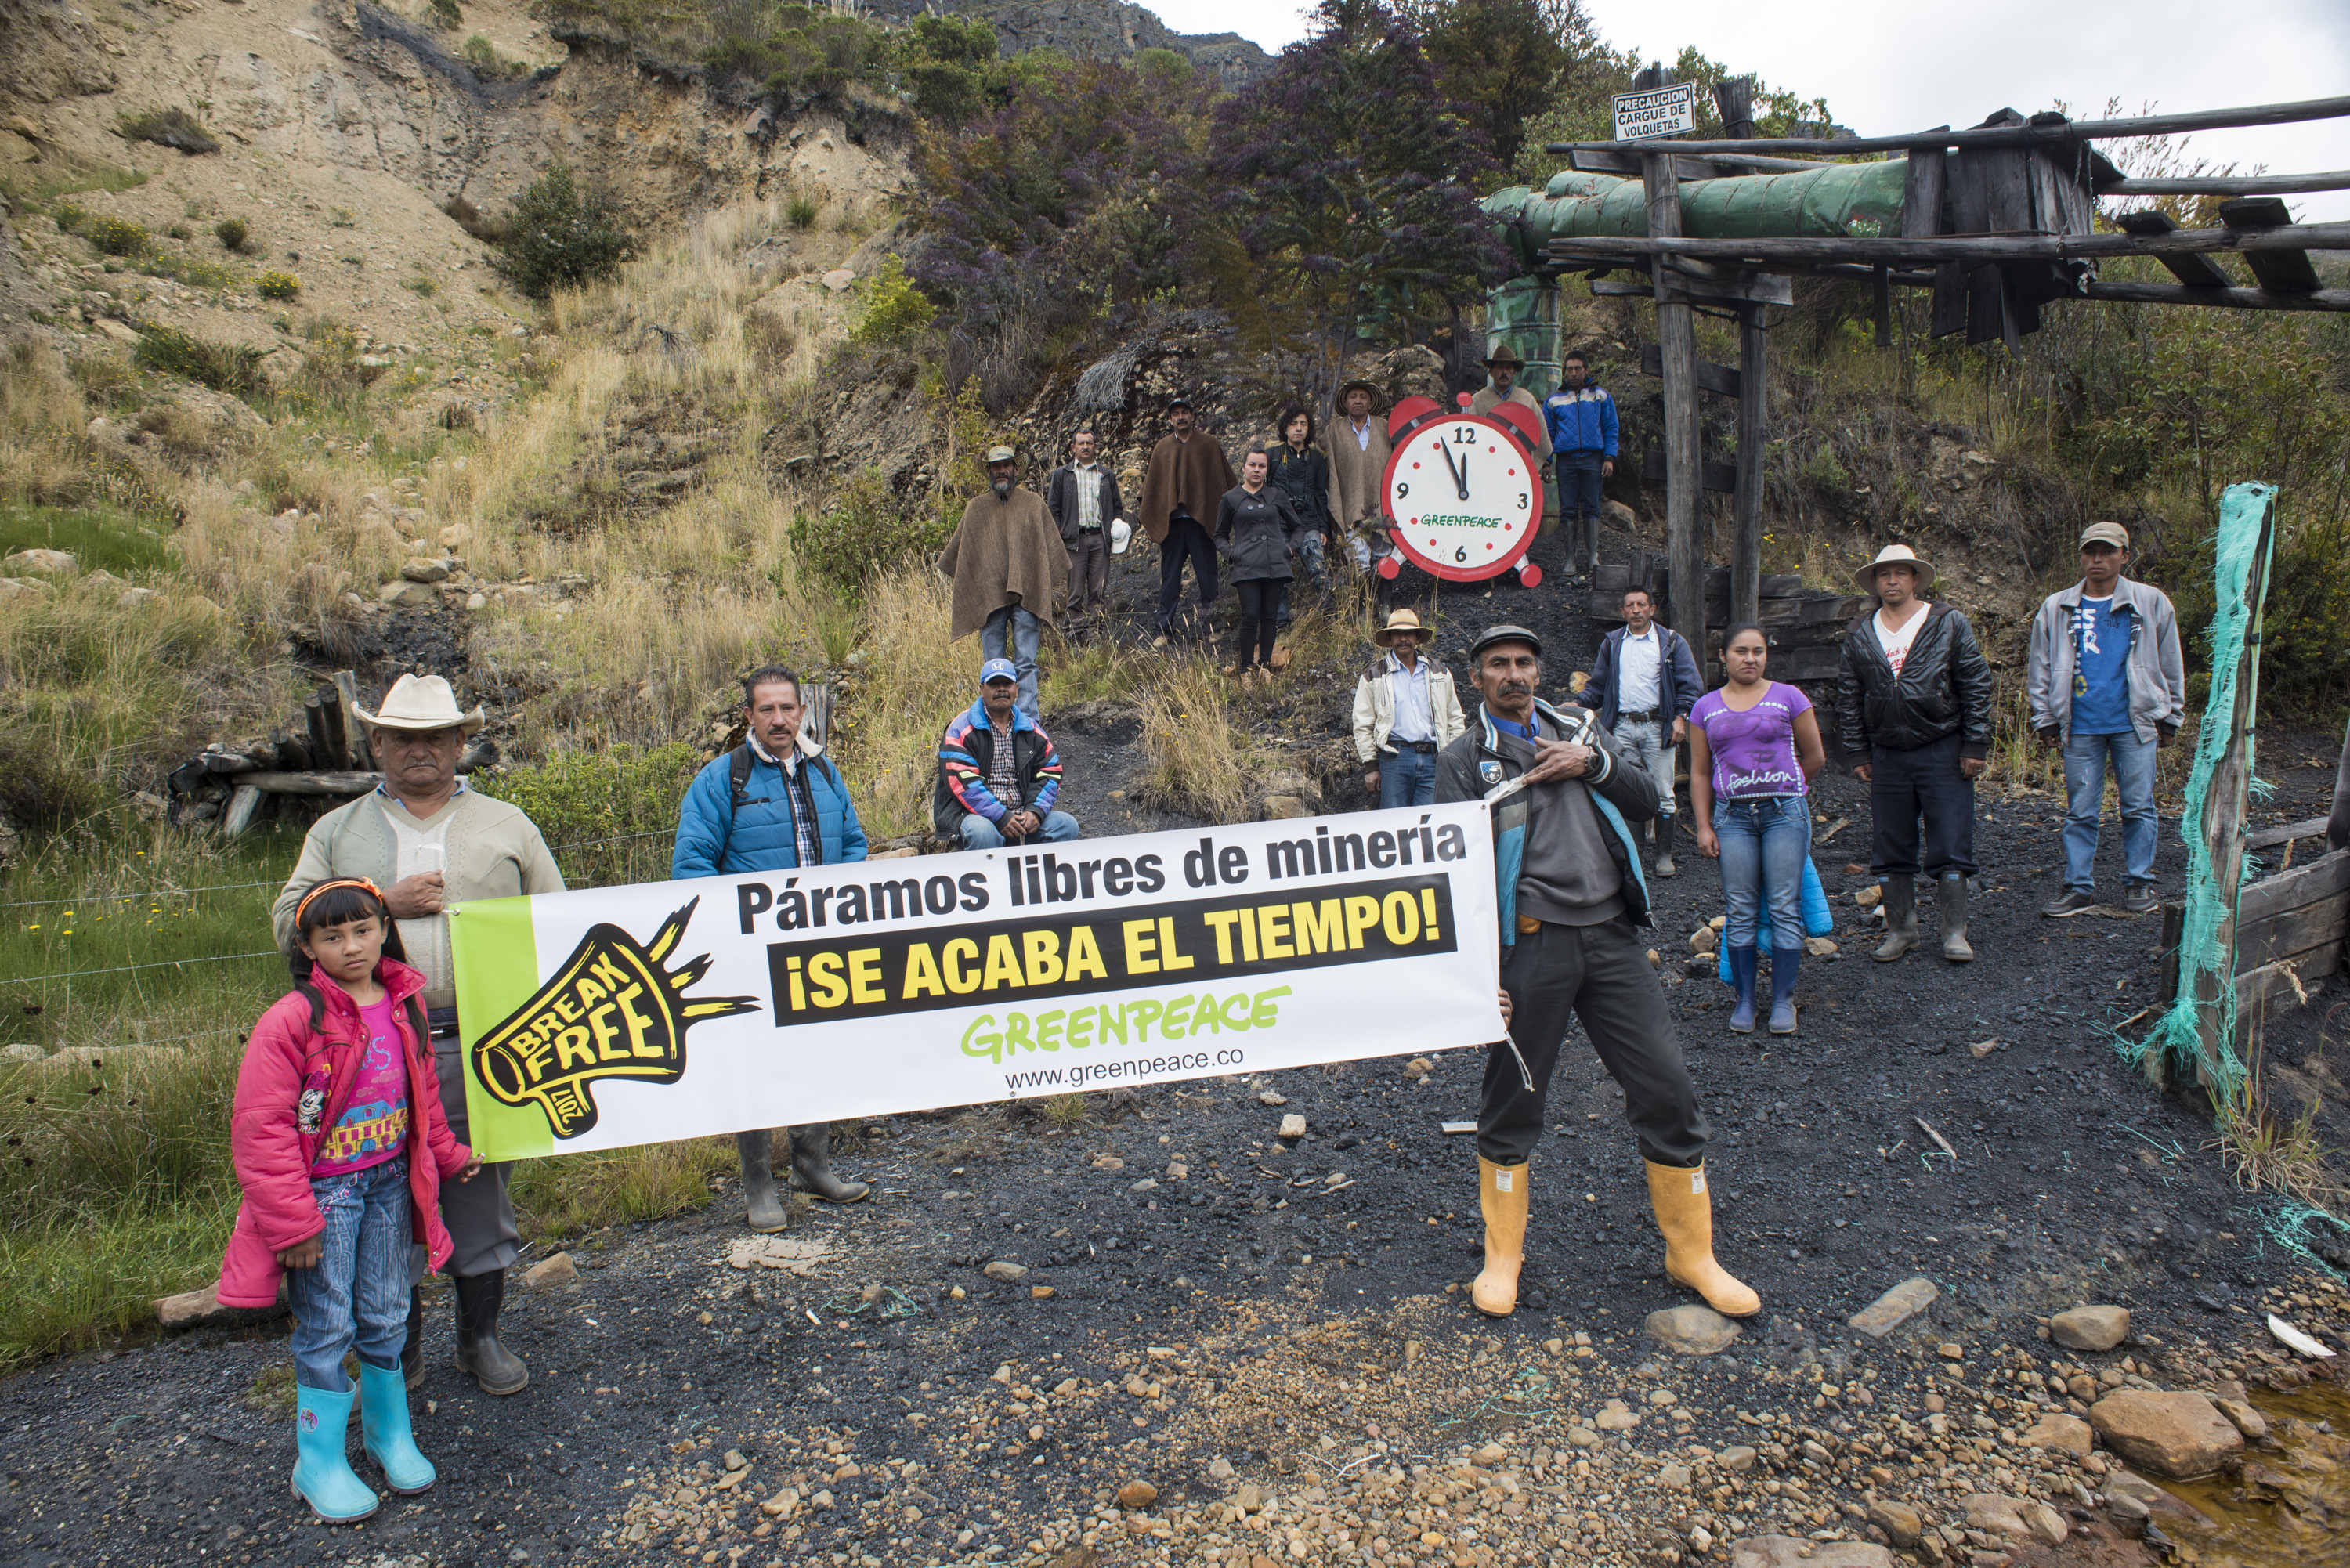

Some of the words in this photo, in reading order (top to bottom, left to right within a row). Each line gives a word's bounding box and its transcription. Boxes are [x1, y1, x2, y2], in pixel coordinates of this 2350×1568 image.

[1618, 89, 1687, 112] PRECAUCION
[1618, 107, 1666, 125] CARGUE
[1671, 103, 1686, 116] DE
[1624, 118, 1679, 138] VOLQUETAS
[1453, 426, 1477, 445] 12
[1397, 482, 1409, 499] 9
[1517, 493, 1528, 510] 3
[1420, 514, 1502, 529] GREENPEACE
[1455, 545, 1466, 562] 6
[1726, 769, 1797, 796] fashion
[737, 873, 990, 934] Páramos
[1007, 851, 1165, 907] libres
[1184, 837, 1249, 888] de
[1267, 814, 1467, 880] minería
[786, 948, 887, 1011] ¡SE
[902, 925, 1108, 999] ACABA
[1123, 916, 1195, 977] EL
[1203, 888, 1441, 965] TIEMPO!
[508, 952, 630, 1058] BREAK
[525, 981, 664, 1082] FREE
[961, 985, 1292, 1064] GREENPEACE
[1005, 1047, 1245, 1089] www.greenpeace.co
[550, 1089, 584, 1125] 2017
